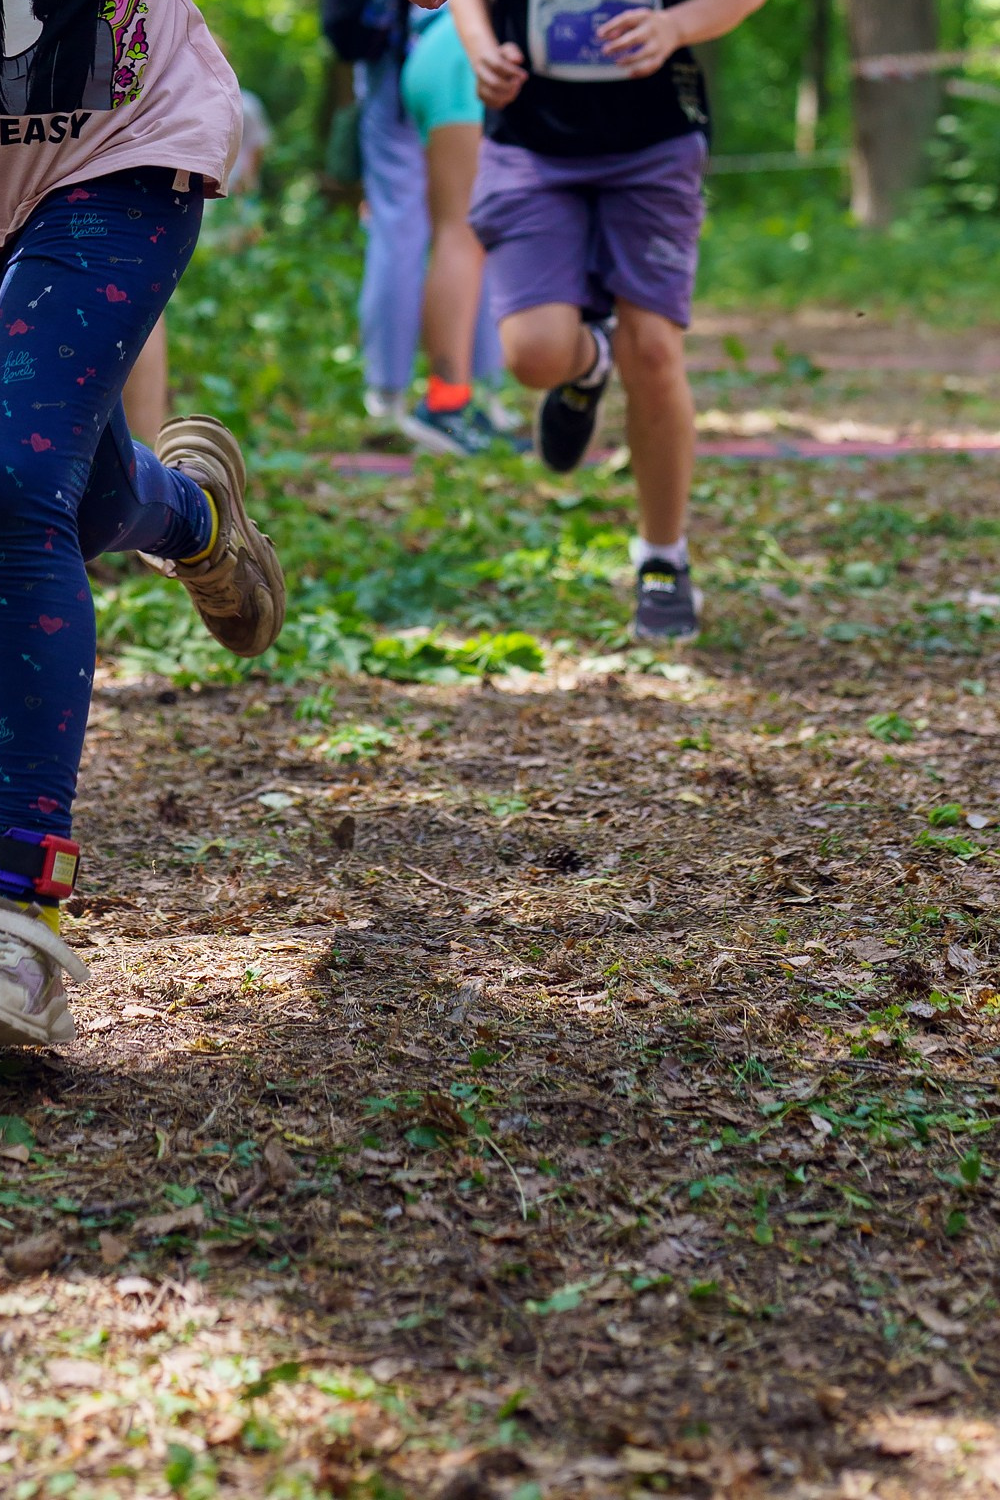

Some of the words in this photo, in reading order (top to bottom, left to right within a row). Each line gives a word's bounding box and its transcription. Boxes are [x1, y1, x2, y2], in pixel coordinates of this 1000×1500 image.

[0, 112, 92, 146] EASY
[1, 350, 38, 368] hello
[1, 365, 36, 384] lovely
